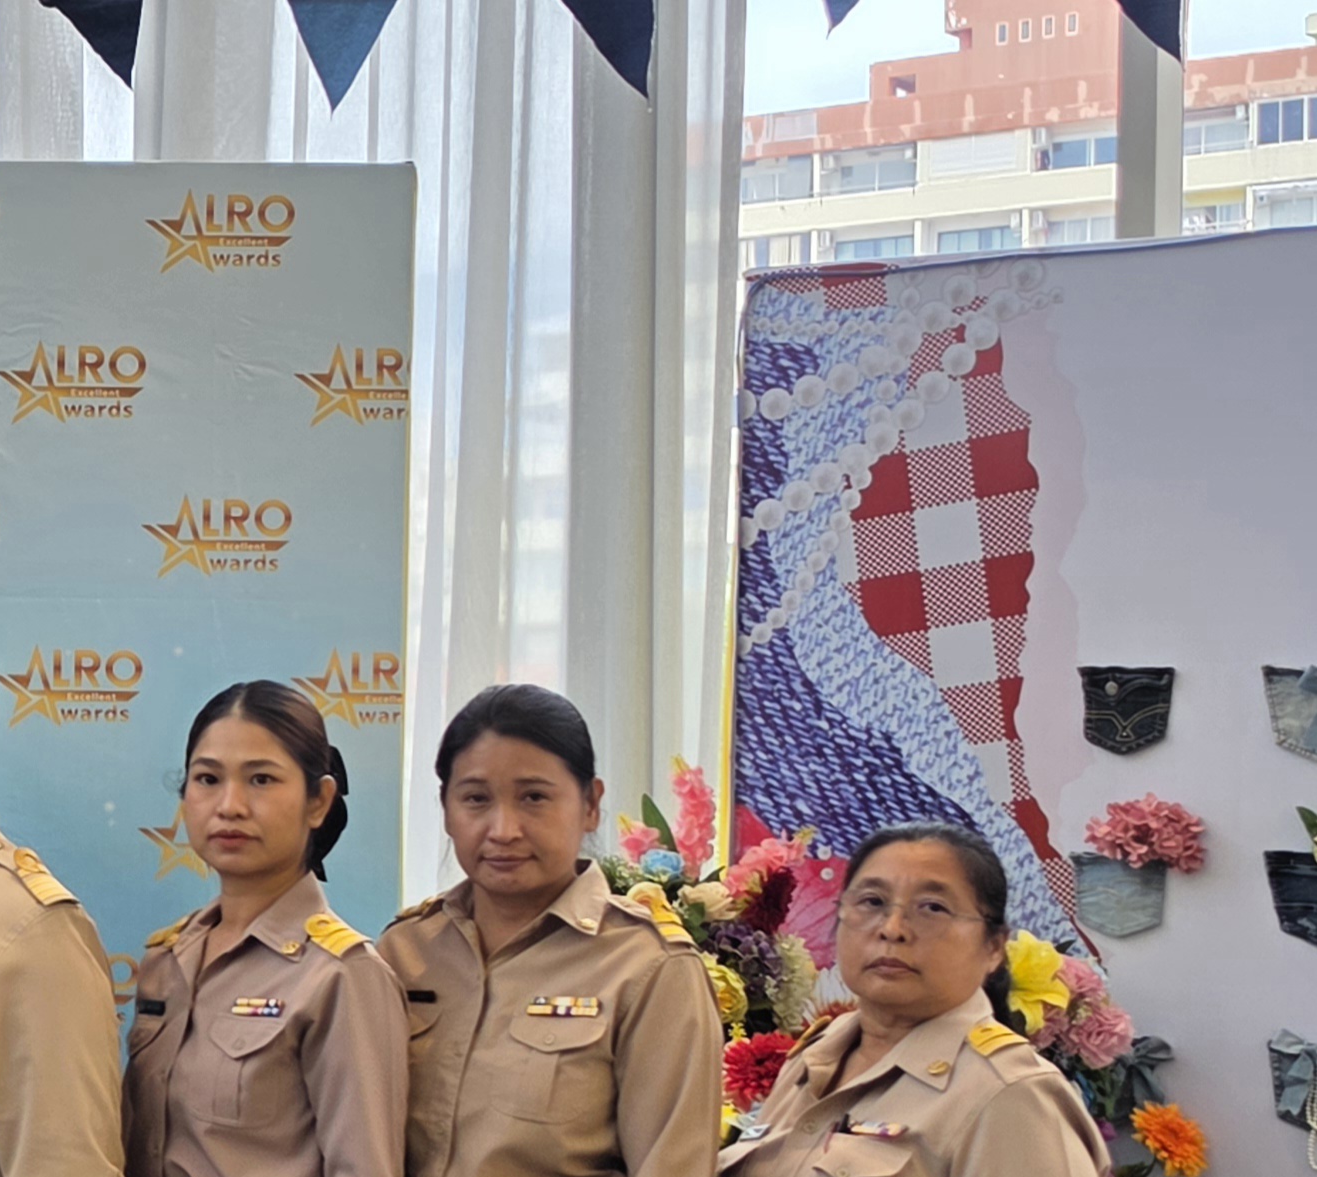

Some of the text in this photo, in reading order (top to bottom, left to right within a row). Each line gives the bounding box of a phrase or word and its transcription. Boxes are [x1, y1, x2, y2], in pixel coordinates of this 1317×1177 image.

[144, 187, 295, 243] ALRO
[218, 237, 269, 247] Excellent
[294, 342, 404, 398] ALR
[70, 389, 120, 398] Excellent
[369, 391, 406, 400] Excelle
[362, 406, 408, 420] war
[141, 495, 292, 551] ALRO
[216, 542, 266, 551] Excellent
[290, 647, 400, 703] ALR
[67, 692, 117, 701] Excellent
[358, 710, 402, 724] war
